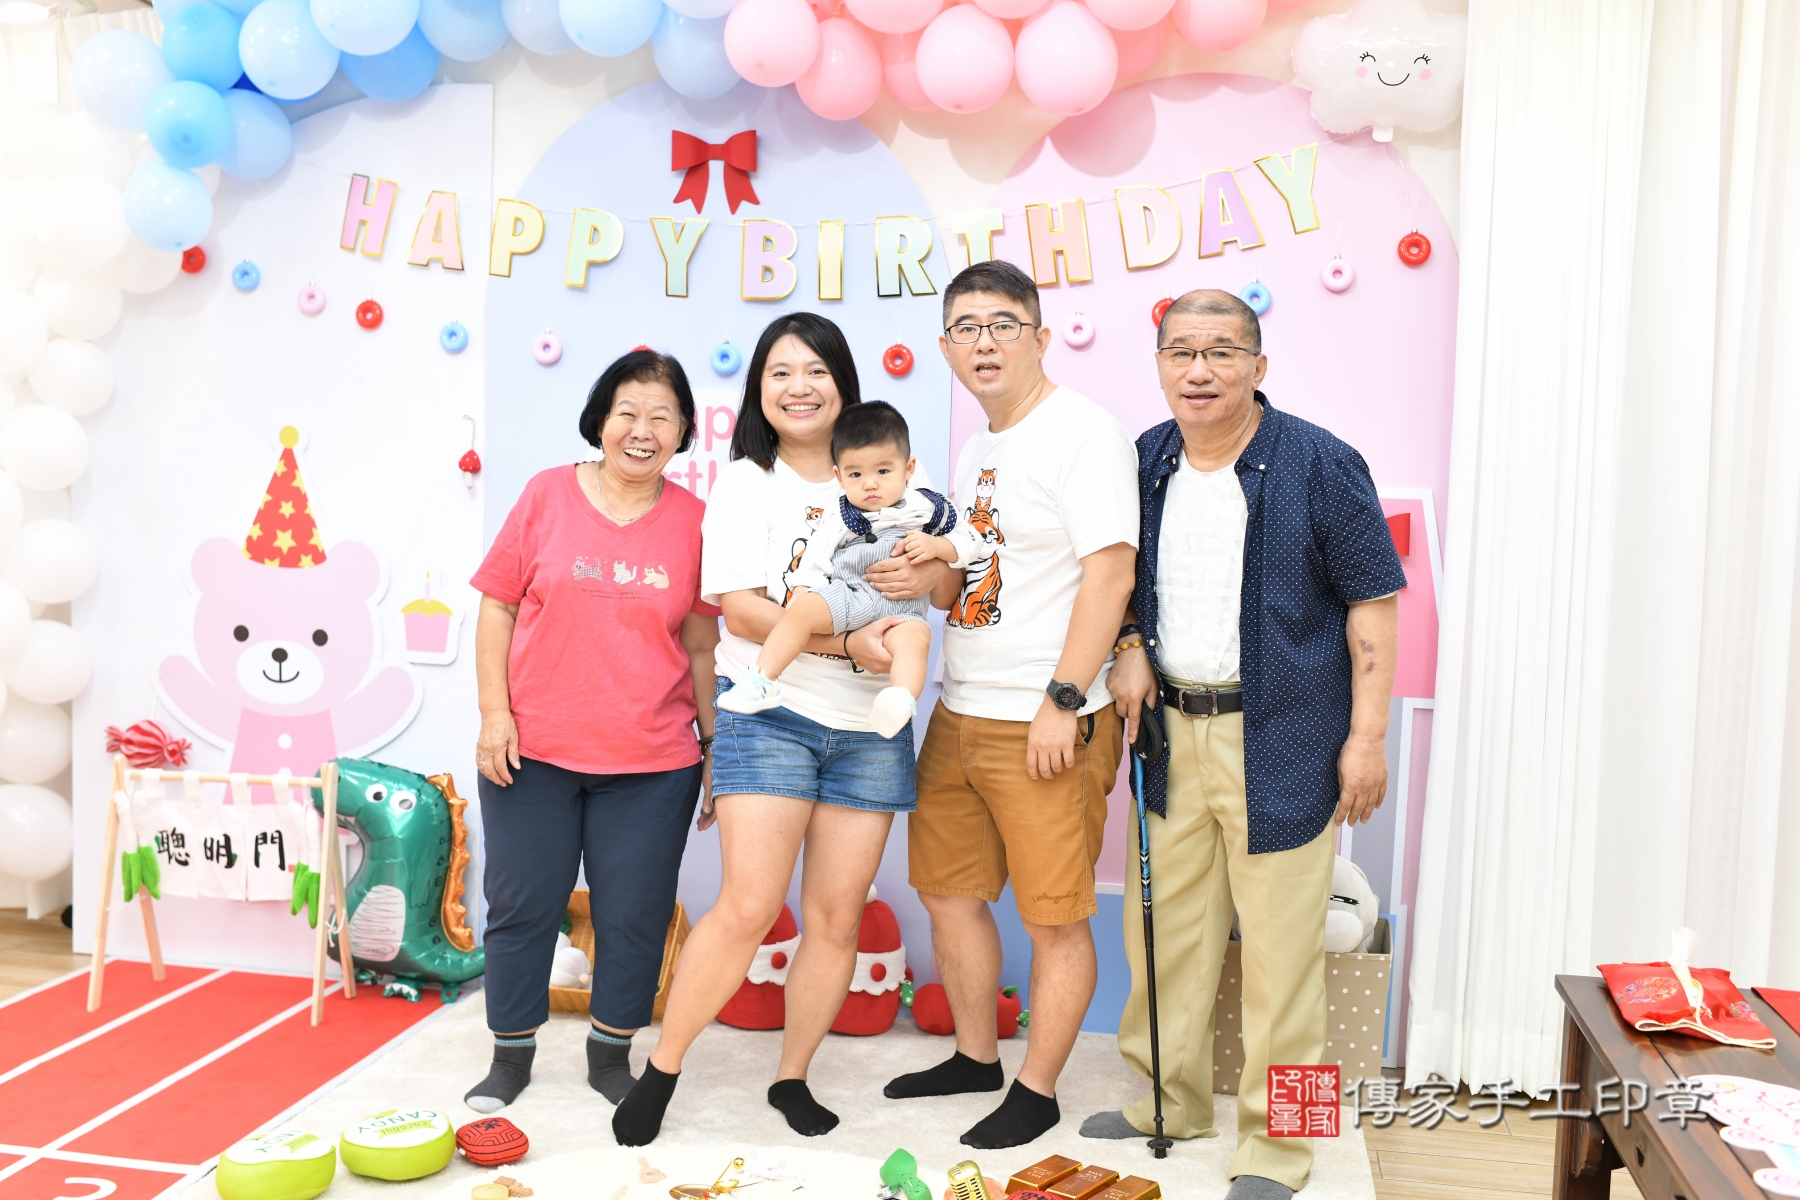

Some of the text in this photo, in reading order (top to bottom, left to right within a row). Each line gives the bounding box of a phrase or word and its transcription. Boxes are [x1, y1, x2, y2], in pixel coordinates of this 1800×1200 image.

[339, 142, 1321, 301] HAPPY BIRTHDAY
[154, 826, 286, 872] 聰明門
[358, 1110, 438, 1134] CANDY
